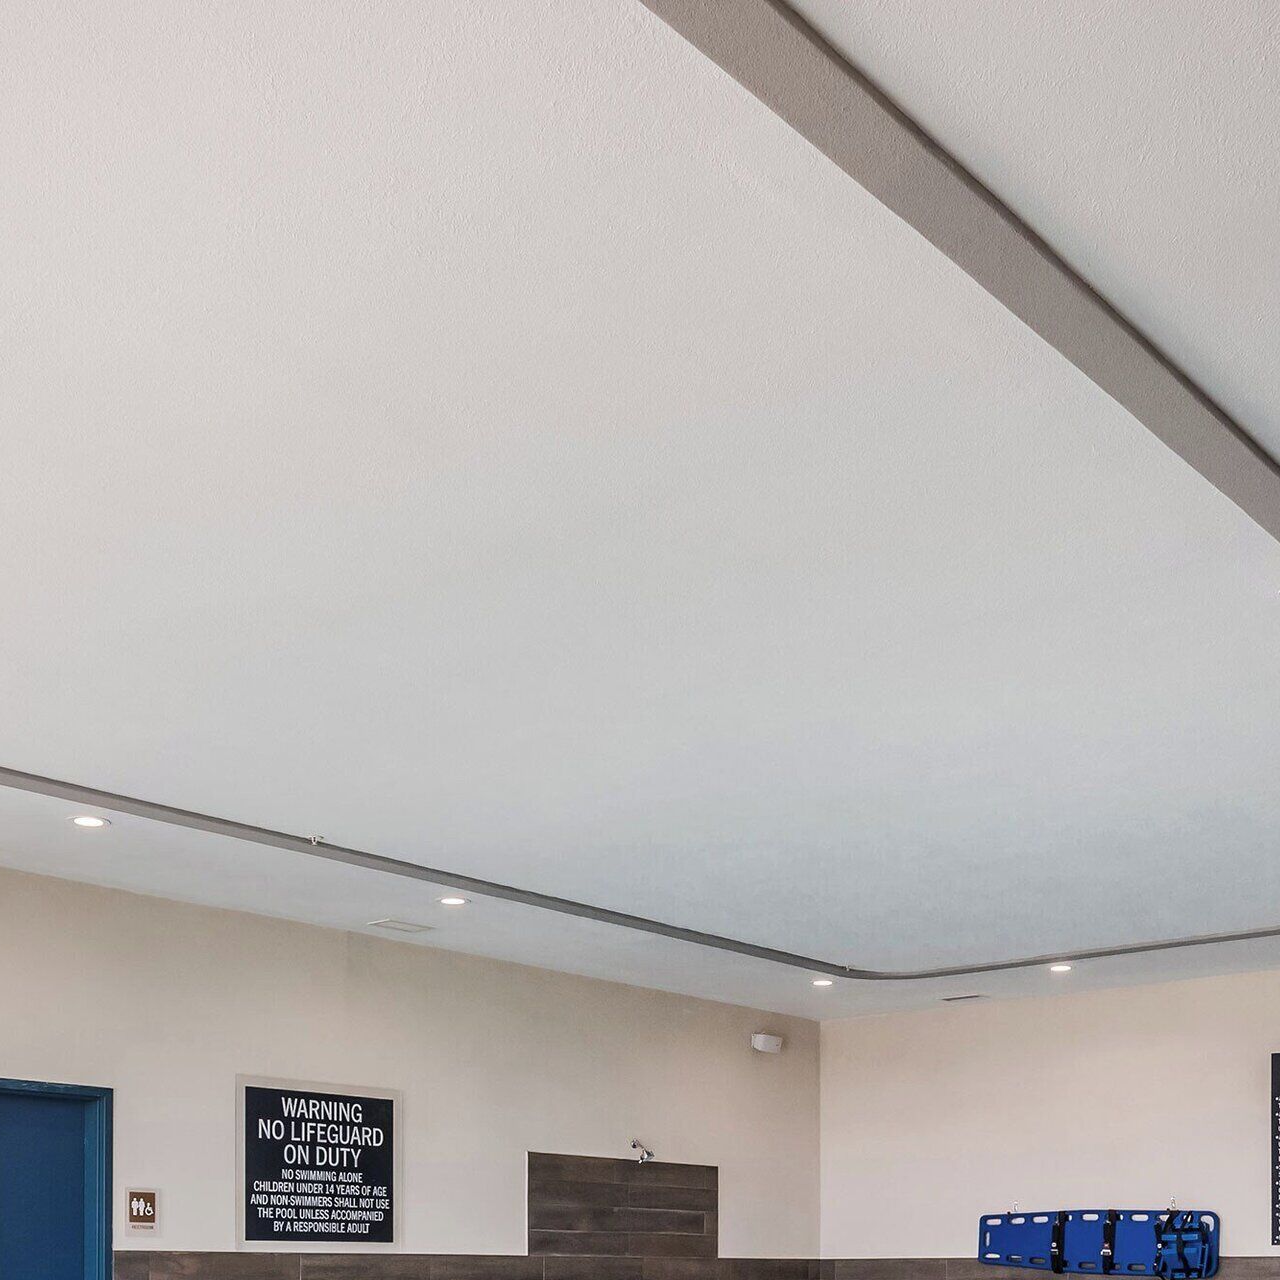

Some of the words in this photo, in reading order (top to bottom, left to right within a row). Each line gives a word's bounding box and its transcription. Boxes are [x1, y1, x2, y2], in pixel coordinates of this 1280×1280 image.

[282, 1097, 362, 1122] WARNING
[258, 1119, 284, 1140] NO
[291, 1121, 383, 1147] LIFEGUARD
[284, 1144, 309, 1164] ON
[316, 1146, 360, 1167] DUTY
[282, 1169, 293, 1179] NO
[295, 1169, 336, 1181] SWIMMING
[338, 1172, 362, 1183] ALONE
[253, 1180, 294, 1193] CHILDREN
[296, 1182, 323, 1194] UNDER
[326, 1184, 334, 1194] 14
[336, 1184, 360, 1195] YEARS
[361, 1185, 371, 1196] OF
[372, 1186, 387, 1196] AGE
[250, 1194, 268, 1205] AND
[270, 1194, 332, 1207] NON-SWIMMERS
[334, 1197, 357, 1208] SHALL
[359, 1198, 374, 1208] NOT
[376, 1198, 389, 1209] USE
[257, 1207, 273, 1218] THE
[276, 1208, 297, 1219] POOL
[299, 1208, 329, 1220] UNLESS
[331, 1209, 383, 1221] ACCOMPANIED
[273, 1221, 284, 1231] BY
[285, 1221, 291, 1232] A
[293, 1221, 345, 1233] RESPONSIBLE
[347, 1223, 369, 1233] ADULT
